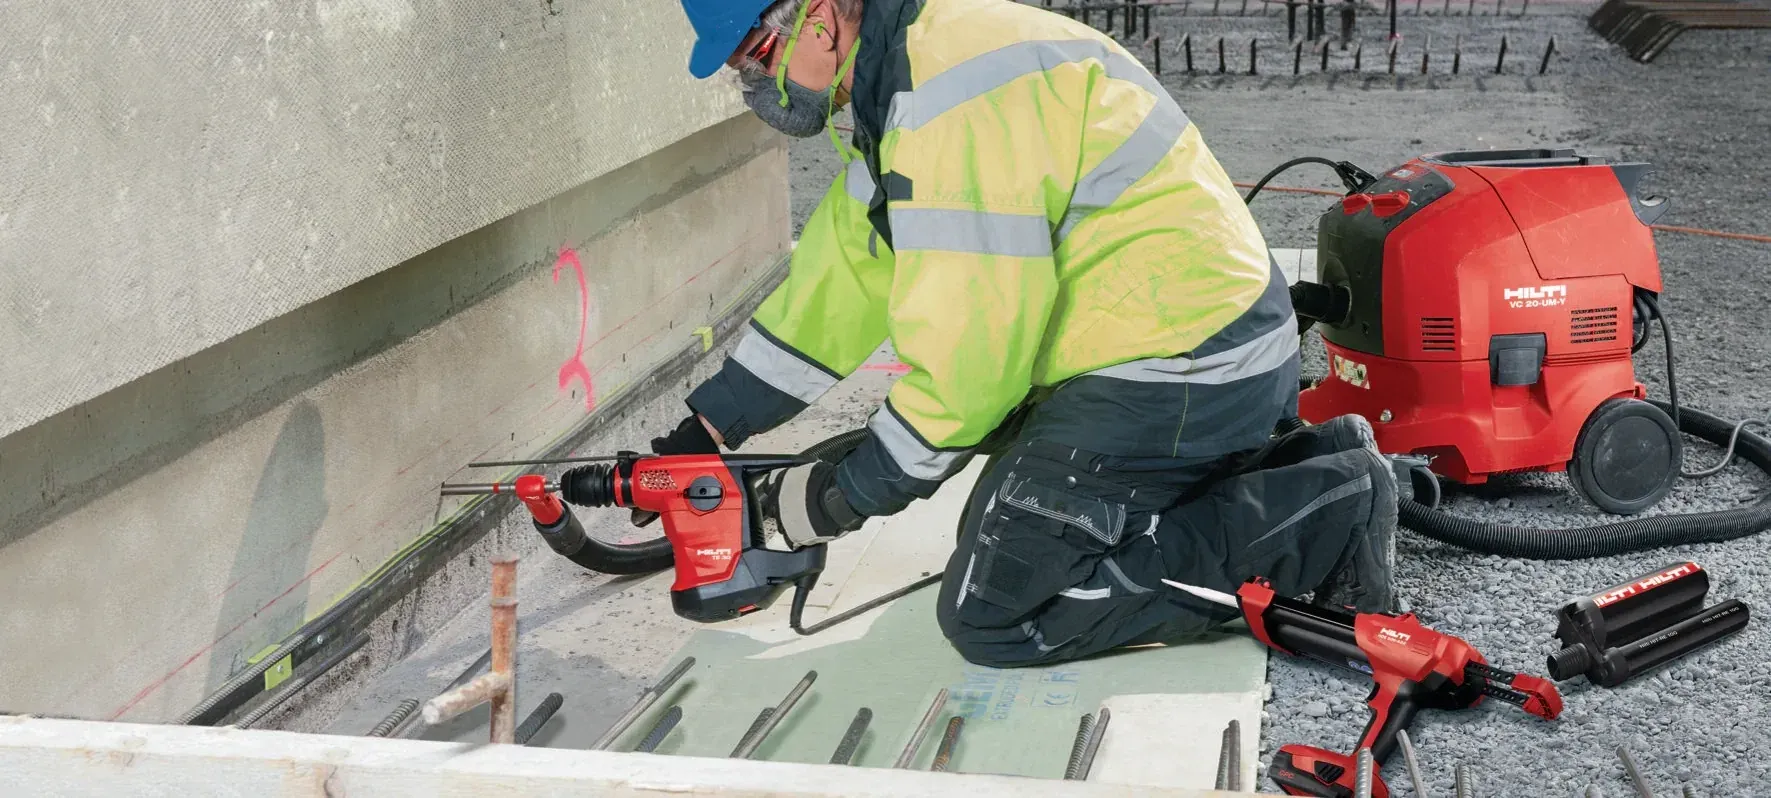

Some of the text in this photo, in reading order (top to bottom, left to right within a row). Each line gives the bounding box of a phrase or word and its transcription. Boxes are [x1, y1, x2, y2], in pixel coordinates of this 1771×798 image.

[1503, 285, 1567, 300] HILTI
[1509, 298, 1566, 309] VC 20-UM-Y
[696, 548, 732, 556] HILTI
[1639, 565, 1691, 590] HILTI
[1379, 627, 1412, 642] HILTI
